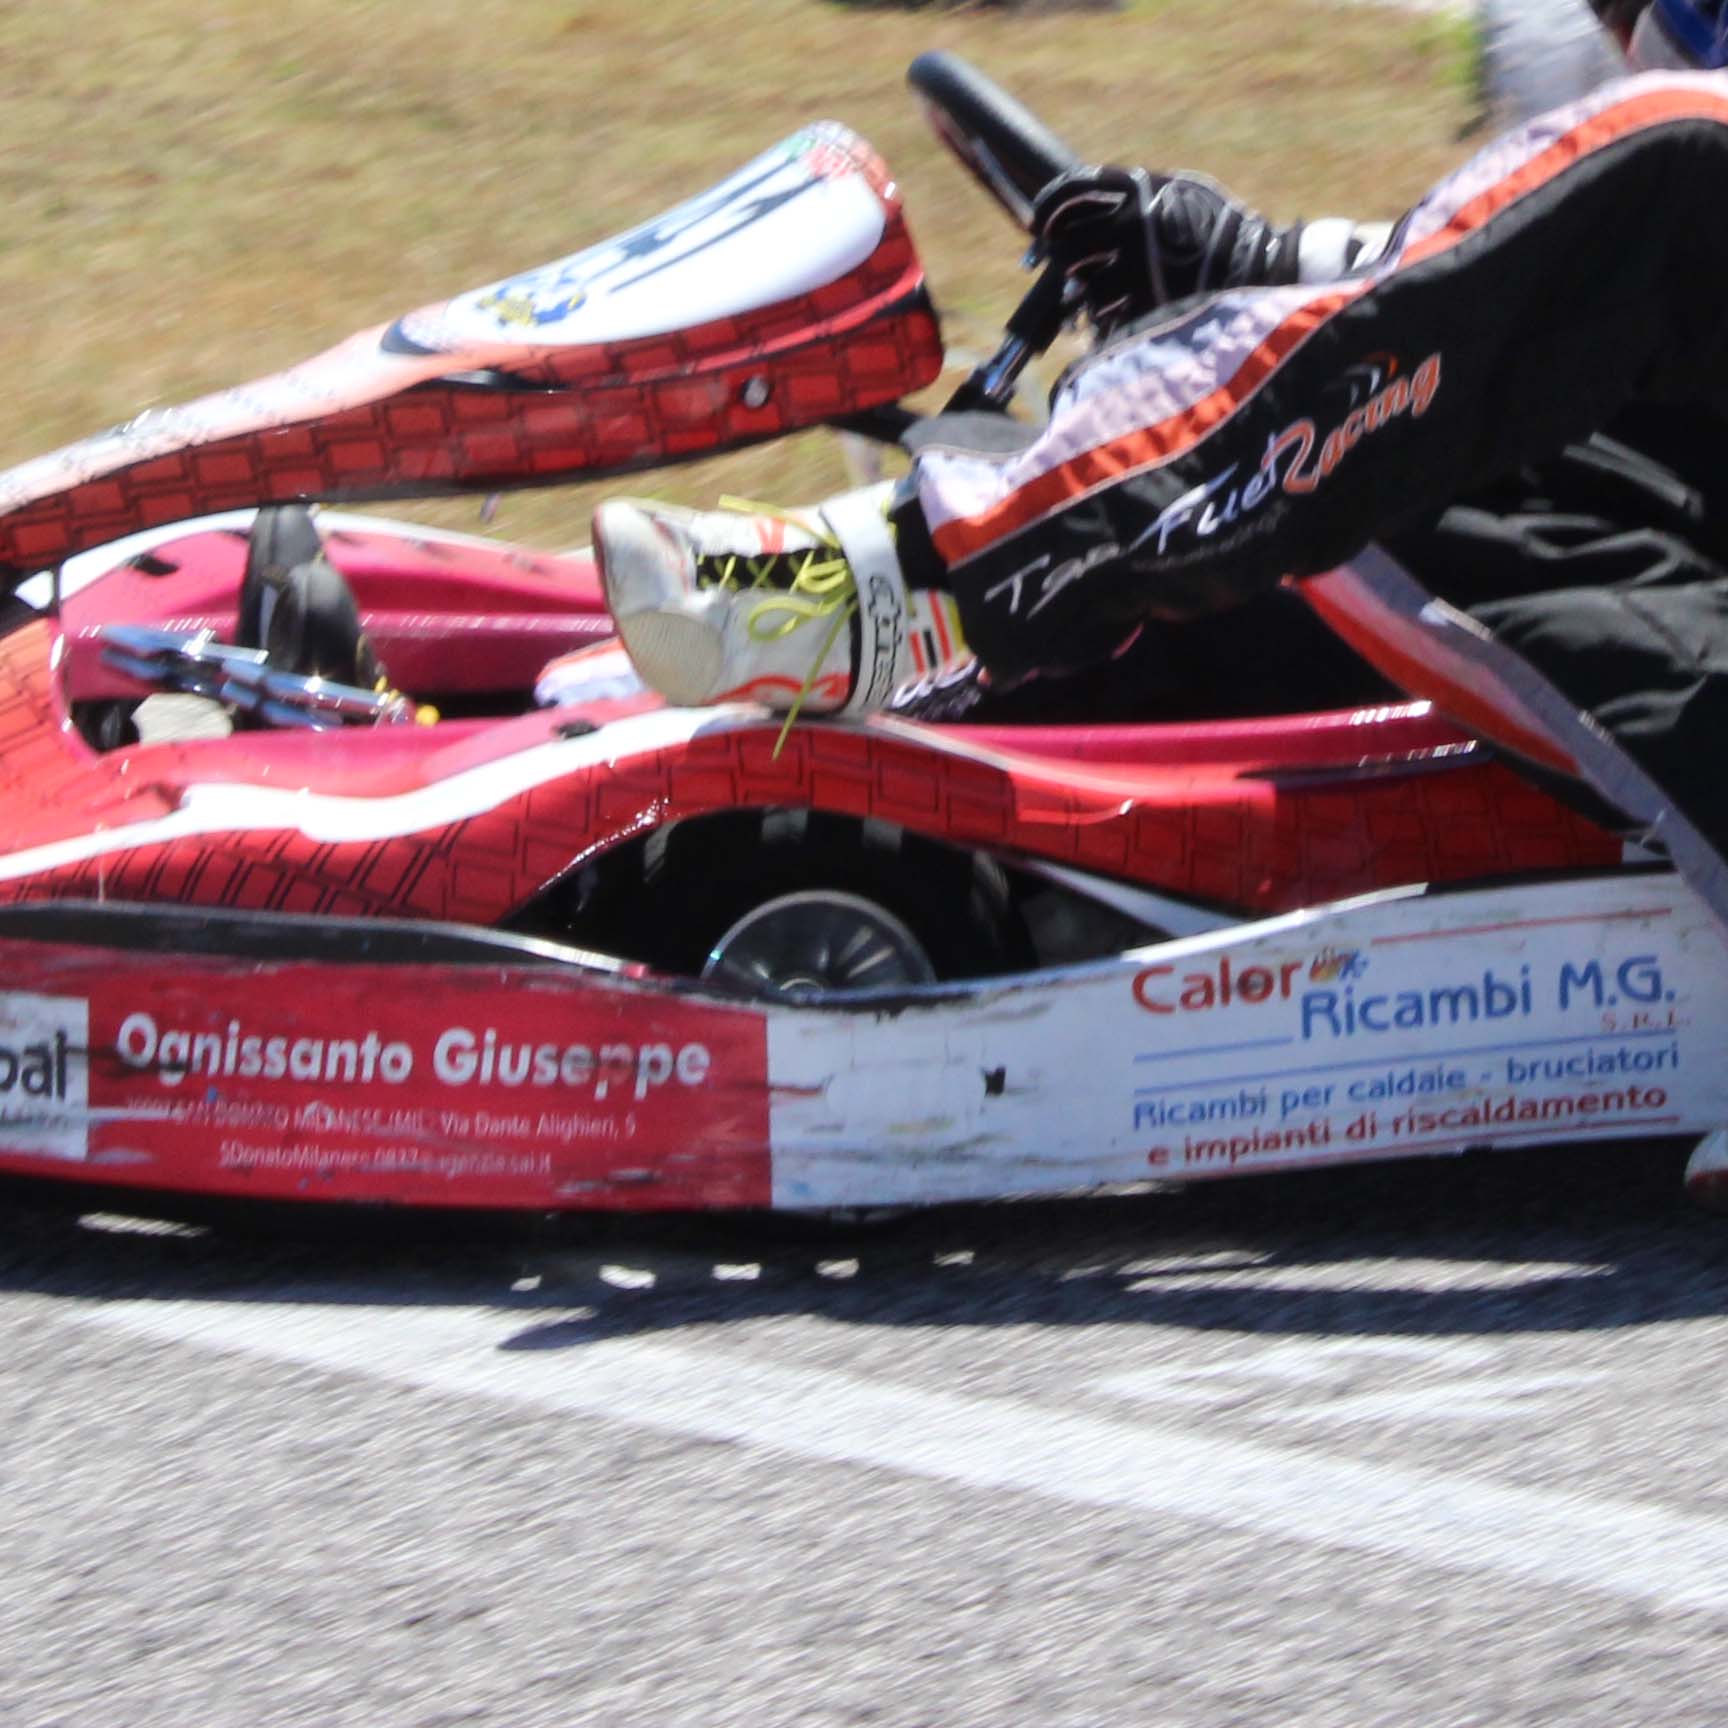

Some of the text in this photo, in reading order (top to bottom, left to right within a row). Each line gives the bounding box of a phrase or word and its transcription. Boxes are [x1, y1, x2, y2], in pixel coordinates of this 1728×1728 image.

[1261, 354, 1440, 494] Racing
[1132, 956, 1303, 1014] Calor
[1300, 954, 1676, 1040] Ricambi M.G.
[117, 1013, 712, 1101] Ognissanto Giuseppe
[1133, 1085, 1268, 1132] Ricambi
[1280, 1084, 1335, 1120] per
[1347, 1063, 1467, 1102] caldaie
[1507, 1041, 1679, 1085] bruciatori
[441, 1111, 470, 1136] Via
[1147, 1084, 1668, 1167] e impianti di riscaldamento
